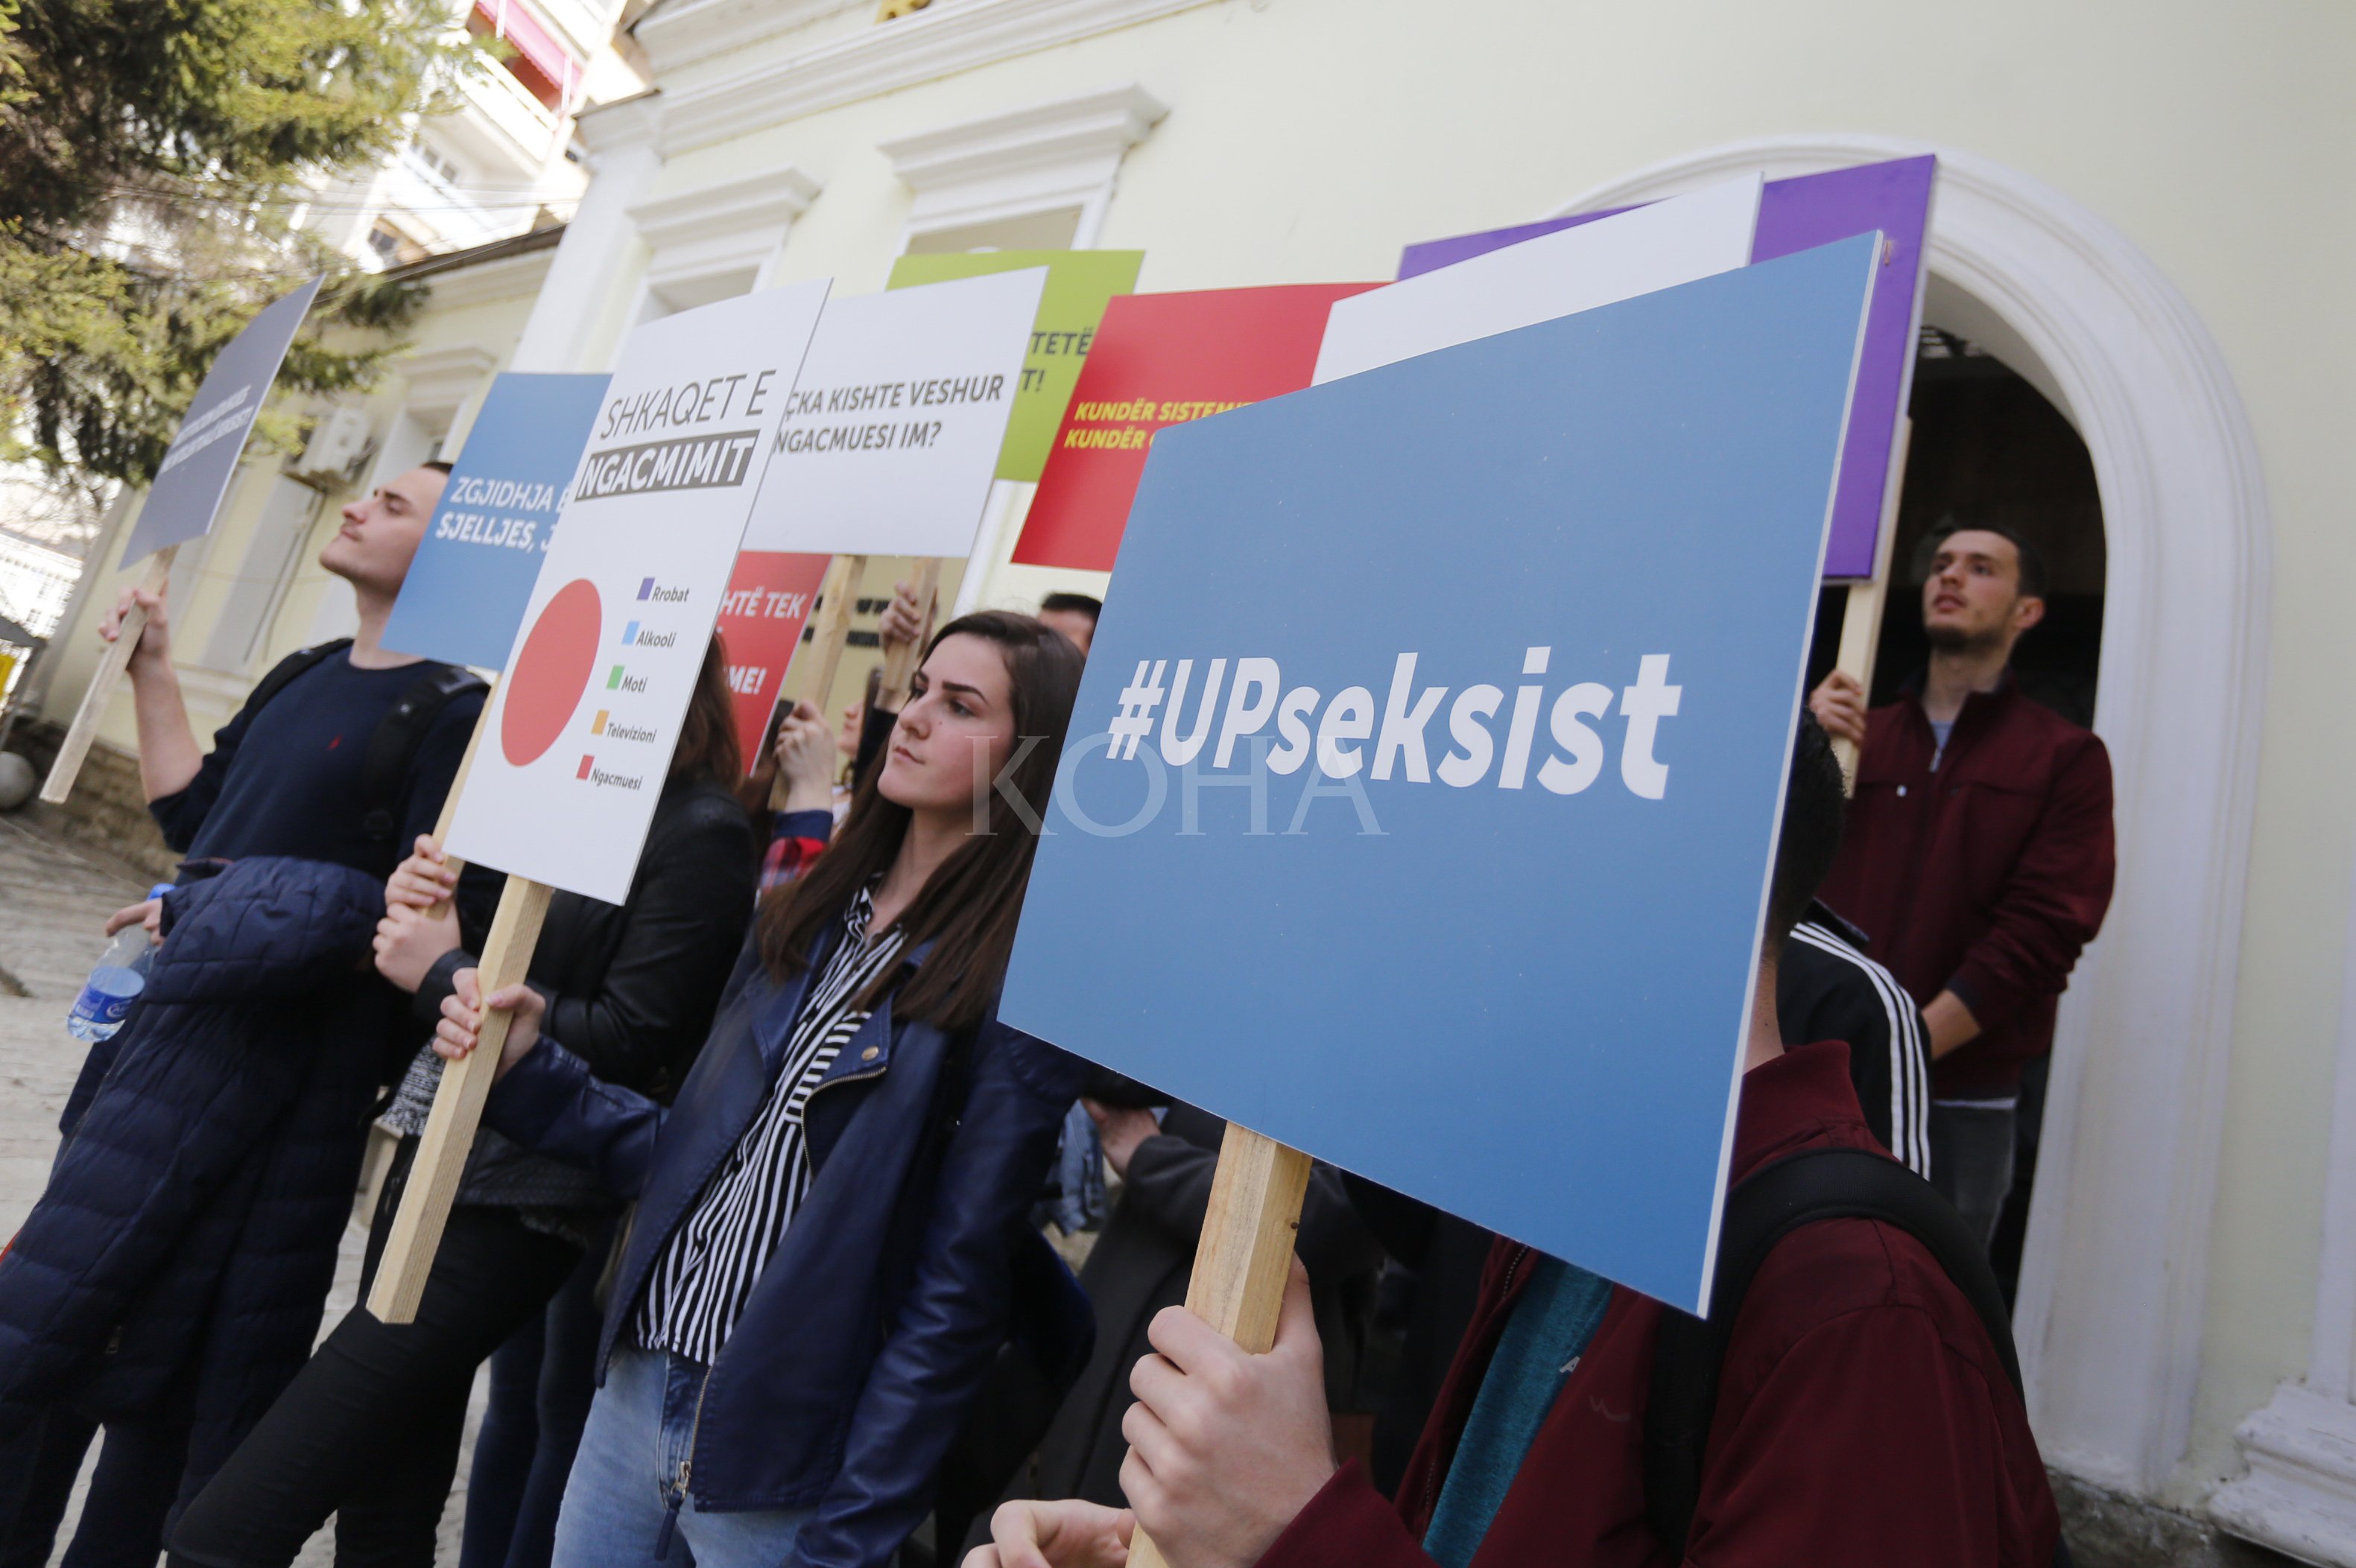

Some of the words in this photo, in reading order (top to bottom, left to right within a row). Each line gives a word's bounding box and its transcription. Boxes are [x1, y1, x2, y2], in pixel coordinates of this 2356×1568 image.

[600, 374, 747, 440] SHKAQET
[746, 369, 777, 416] E
[827, 382, 905, 413] KISHTE
[908, 374, 1004, 407] VESHUR
[1073, 397, 1157, 422] KUNDËR
[773, 422, 896, 454] NGACMUESI
[899, 421, 942, 448] IM?
[1064, 425, 1147, 449] KUNDËR
[577, 437, 757, 499] NGACMIMIT
[450, 476, 555, 512] ZGJIDHJA
[435, 511, 537, 553] SJELLJES,
[651, 586, 690, 603] Rrobat
[764, 591, 807, 619] TEK
[636, 631, 677, 648] Alkooli
[621, 676, 648, 693] Moti
[607, 723, 658, 743] Televizioni
[1107, 645, 1683, 801] #UPseksist
[591, 767, 643, 790] Ngacmuesi
